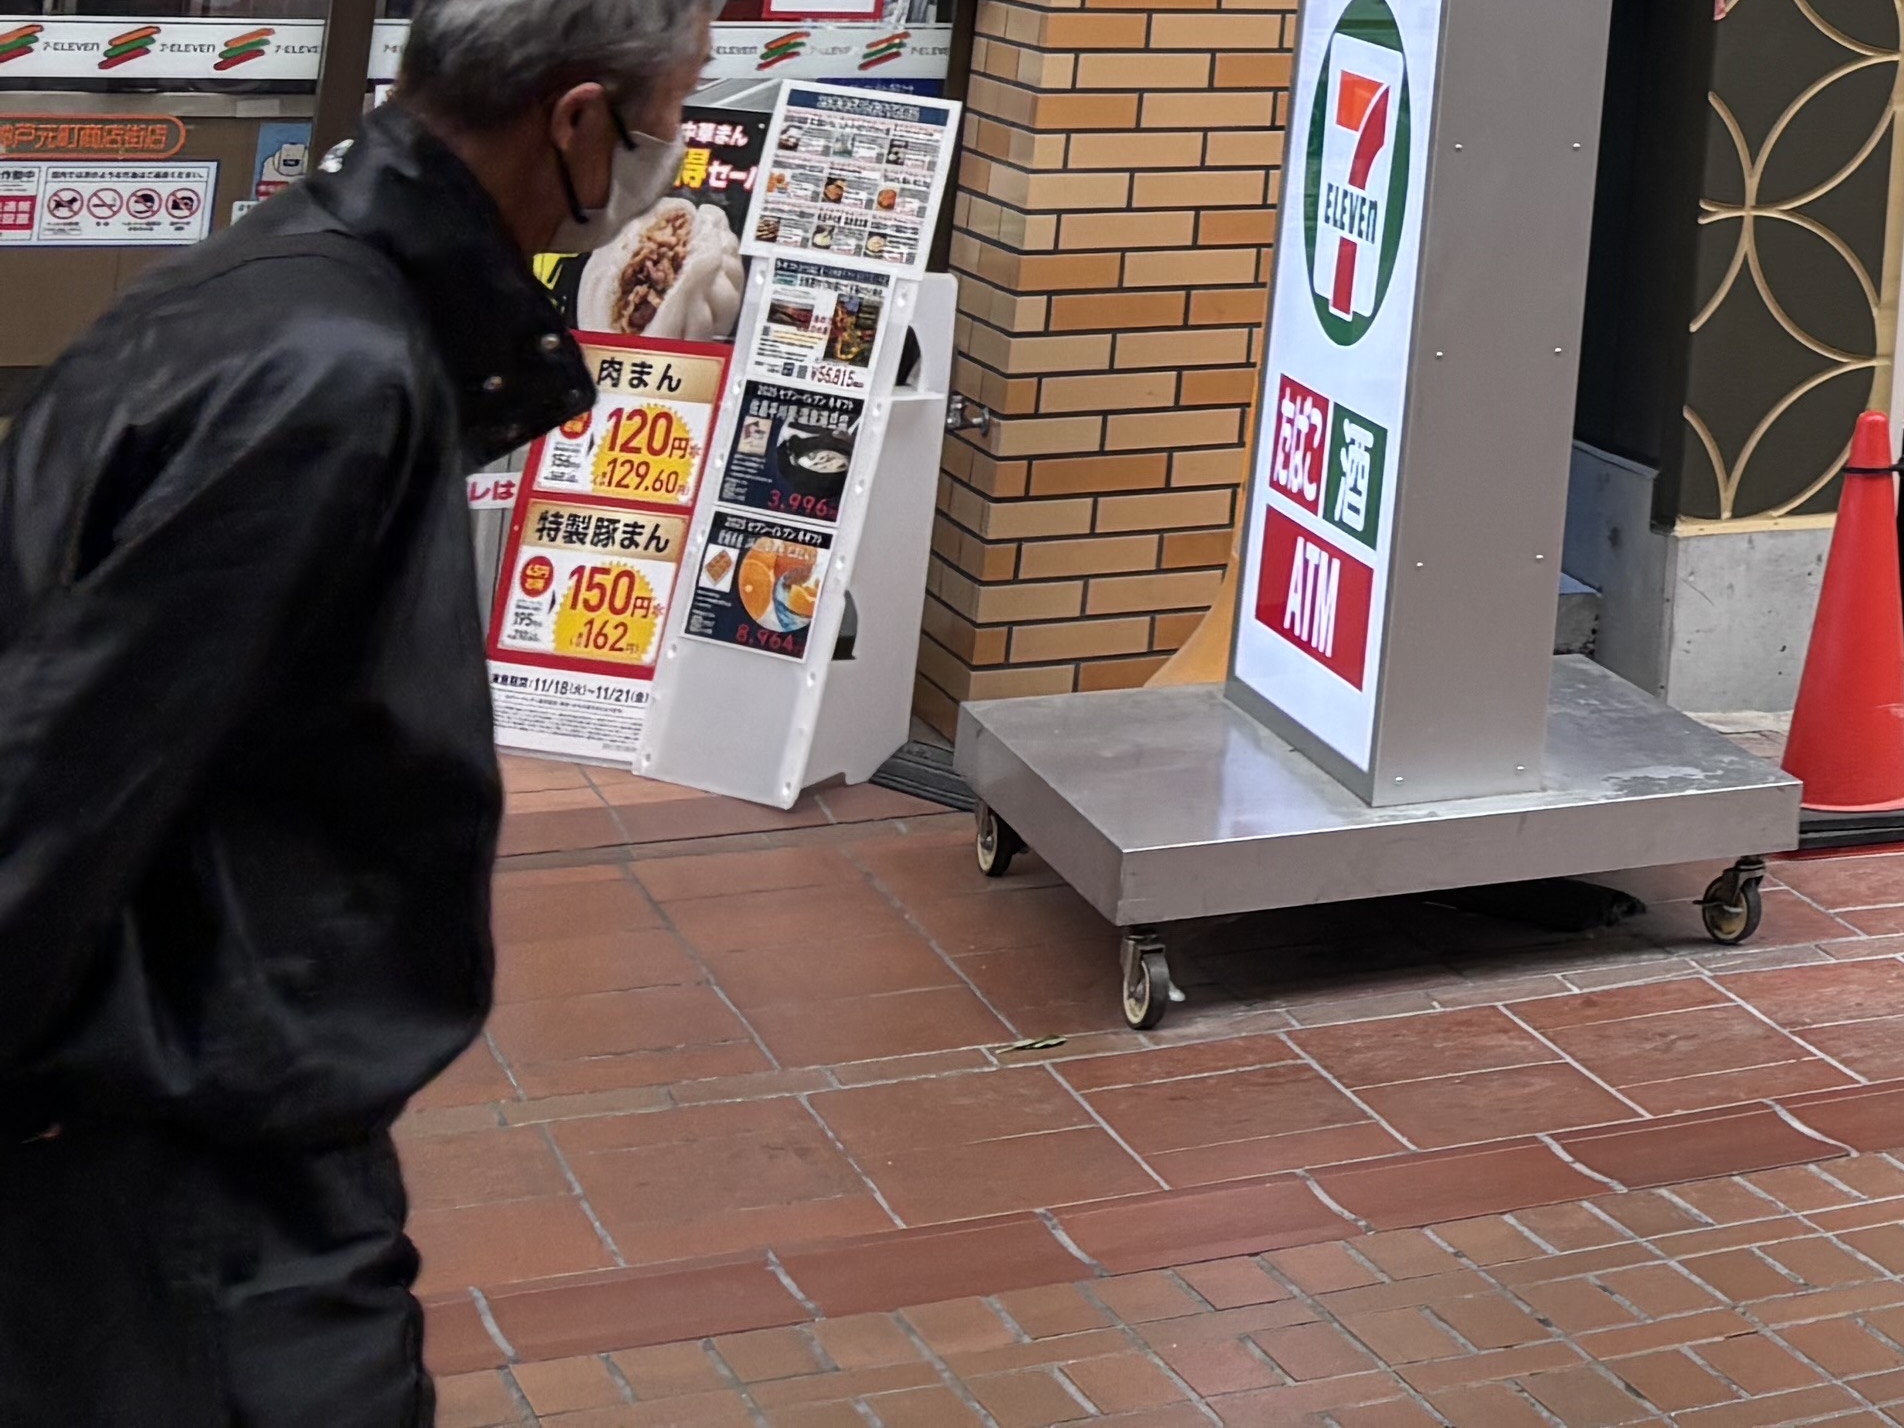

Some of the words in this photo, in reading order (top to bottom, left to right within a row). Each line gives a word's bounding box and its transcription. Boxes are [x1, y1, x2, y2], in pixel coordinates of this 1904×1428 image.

[682, 121, 749, 147] 中華まん
[597, 356, 682, 393] 肉まん
[1273, 386, 1323, 503] たばこ
[1333, 417, 1374, 533] 酒
[535, 509, 670, 554] 特製豚まん
[1283, 535, 1341, 659] ATM
